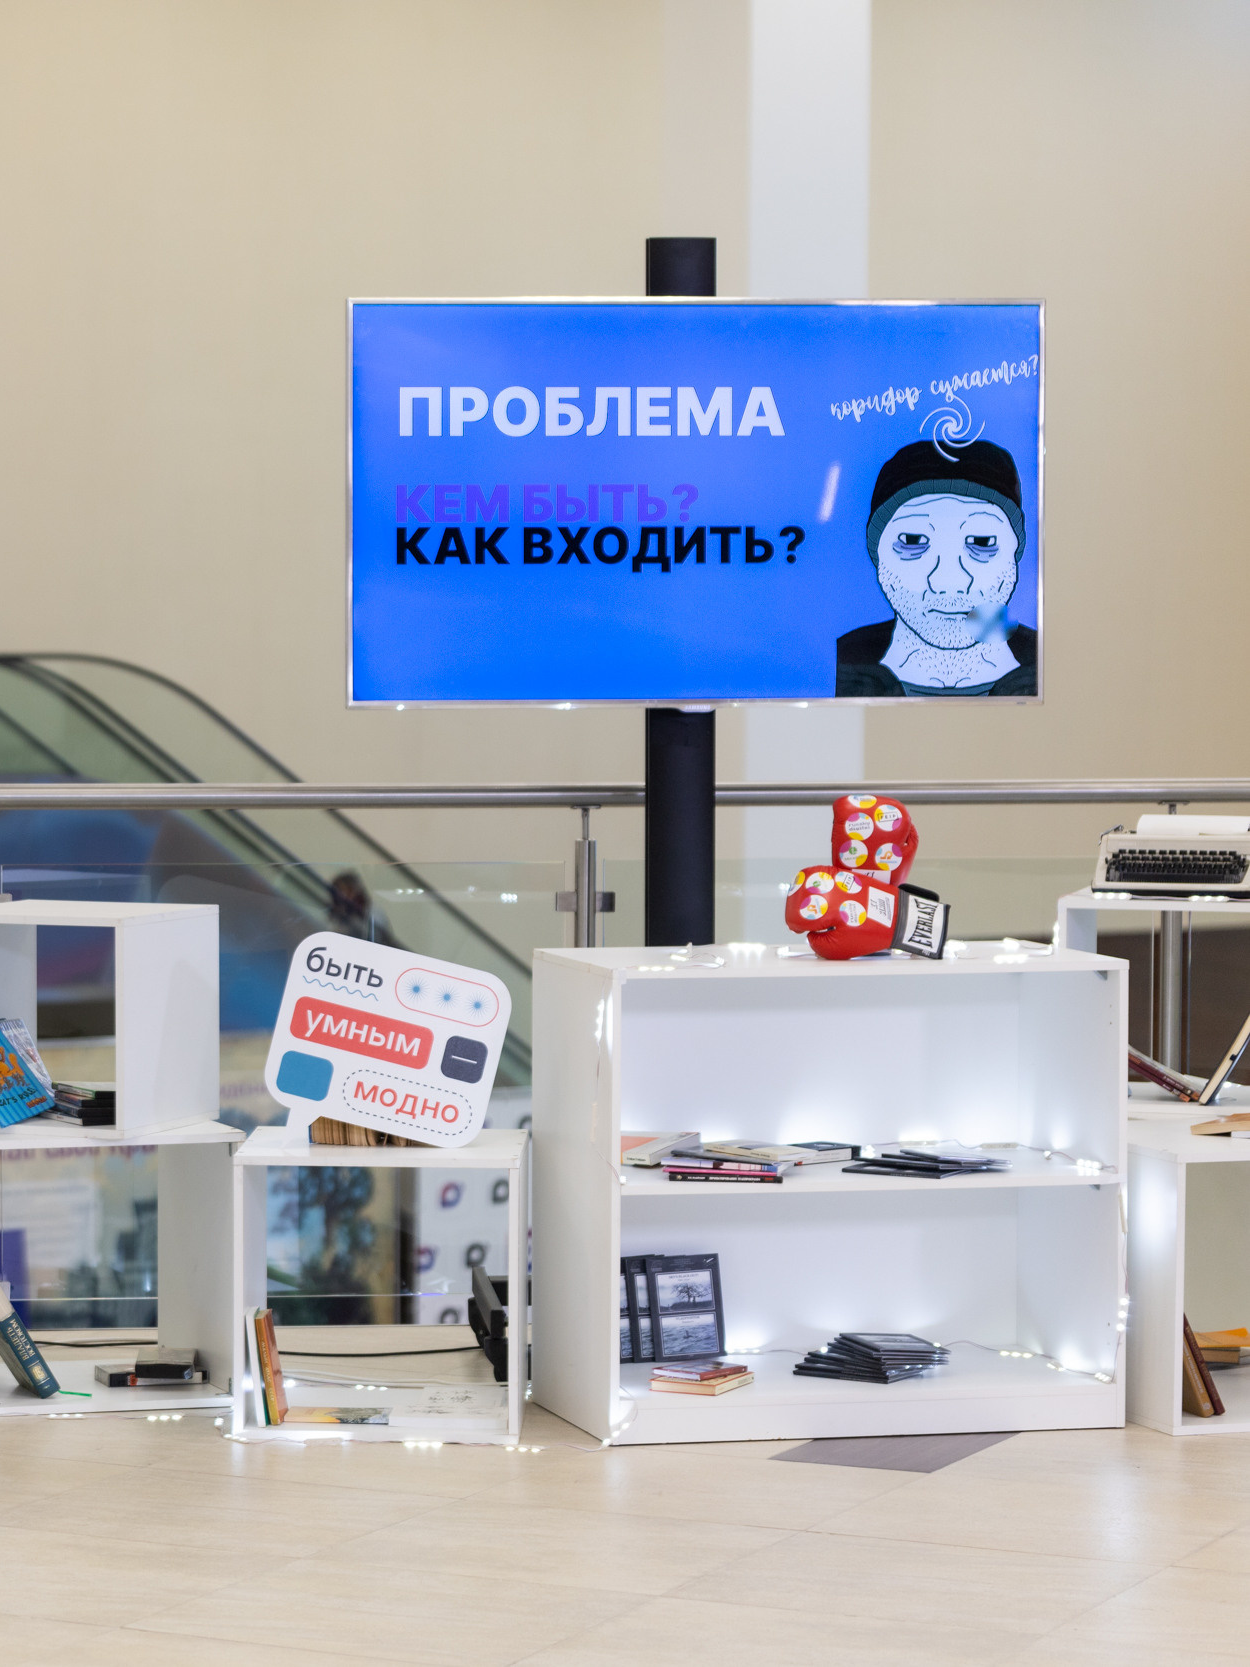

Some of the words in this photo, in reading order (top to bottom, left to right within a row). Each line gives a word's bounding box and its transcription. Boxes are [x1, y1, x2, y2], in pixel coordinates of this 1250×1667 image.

[830, 386, 923, 423] коридор
[930, 354, 1039, 402] сужается?
[399, 386, 786, 437] ПРОБЛЕМА
[396, 484, 510, 523] КЕМ
[523, 483, 699, 523] БЫТЬ?
[396, 527, 510, 565] КАК
[523, 525, 806, 573] ВХОДИТЬ?
[908, 898, 938, 948] EVERLAST
[306, 947, 383, 988] быть
[306, 1010, 421, 1057] умным
[354, 1081, 459, 1123] модно
[7, 1327, 30, 1360] ВЛАДЕТЬ
[10, 1318, 36, 1357] ВОСТОКОМ
